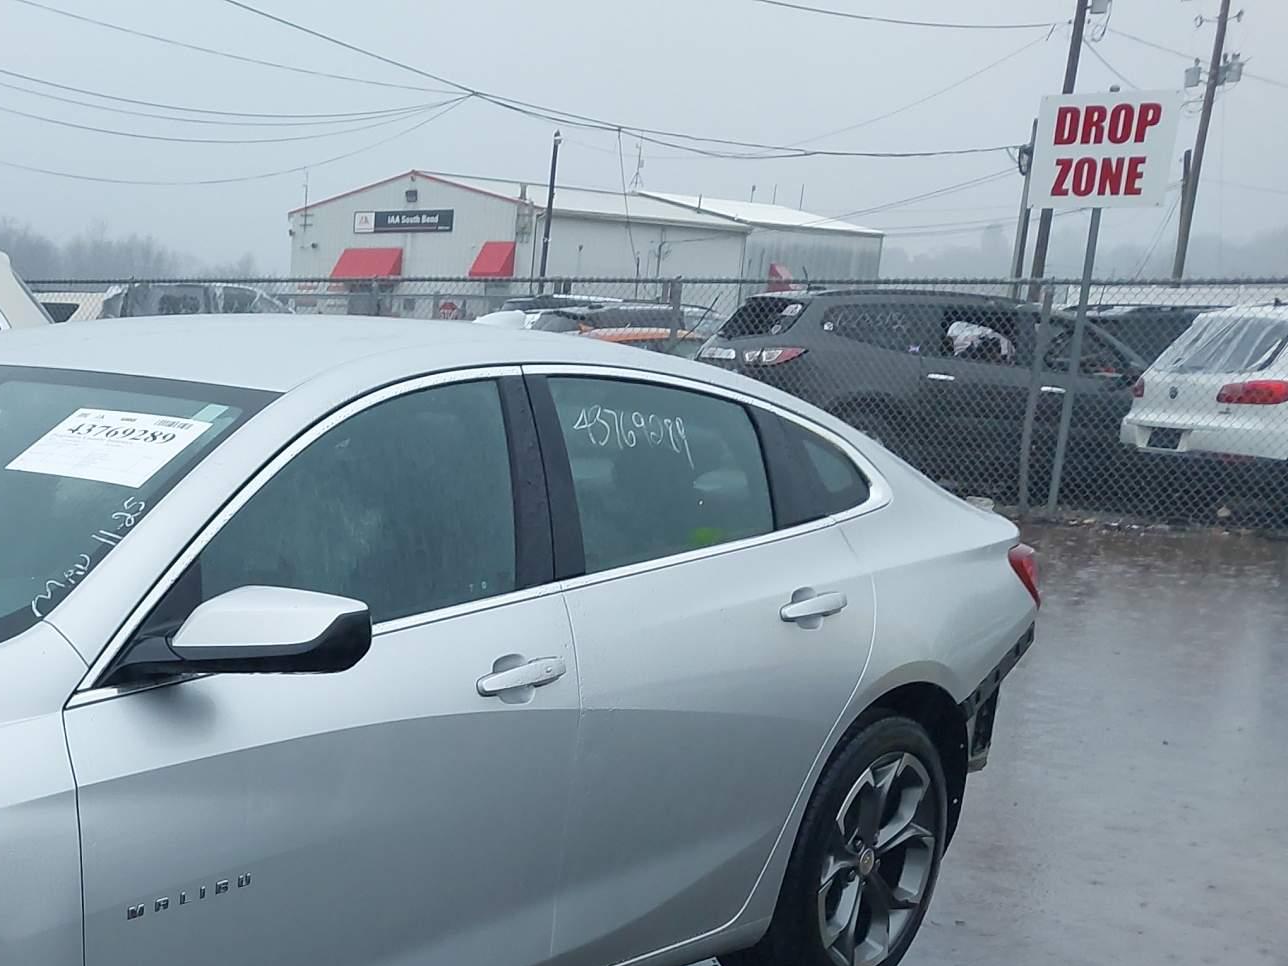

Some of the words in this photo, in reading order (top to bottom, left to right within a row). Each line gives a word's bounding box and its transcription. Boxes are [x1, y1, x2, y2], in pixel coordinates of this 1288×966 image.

[1054, 103, 1162, 145] DROP
[1050, 156, 1147, 197] ZONE
[387, 215, 400, 224] IAA
[401, 214, 420, 224] South
[421, 213, 439, 224] Bend
[67, 423, 177, 444] 43769289
[127, 872, 251, 920] MALIBU
